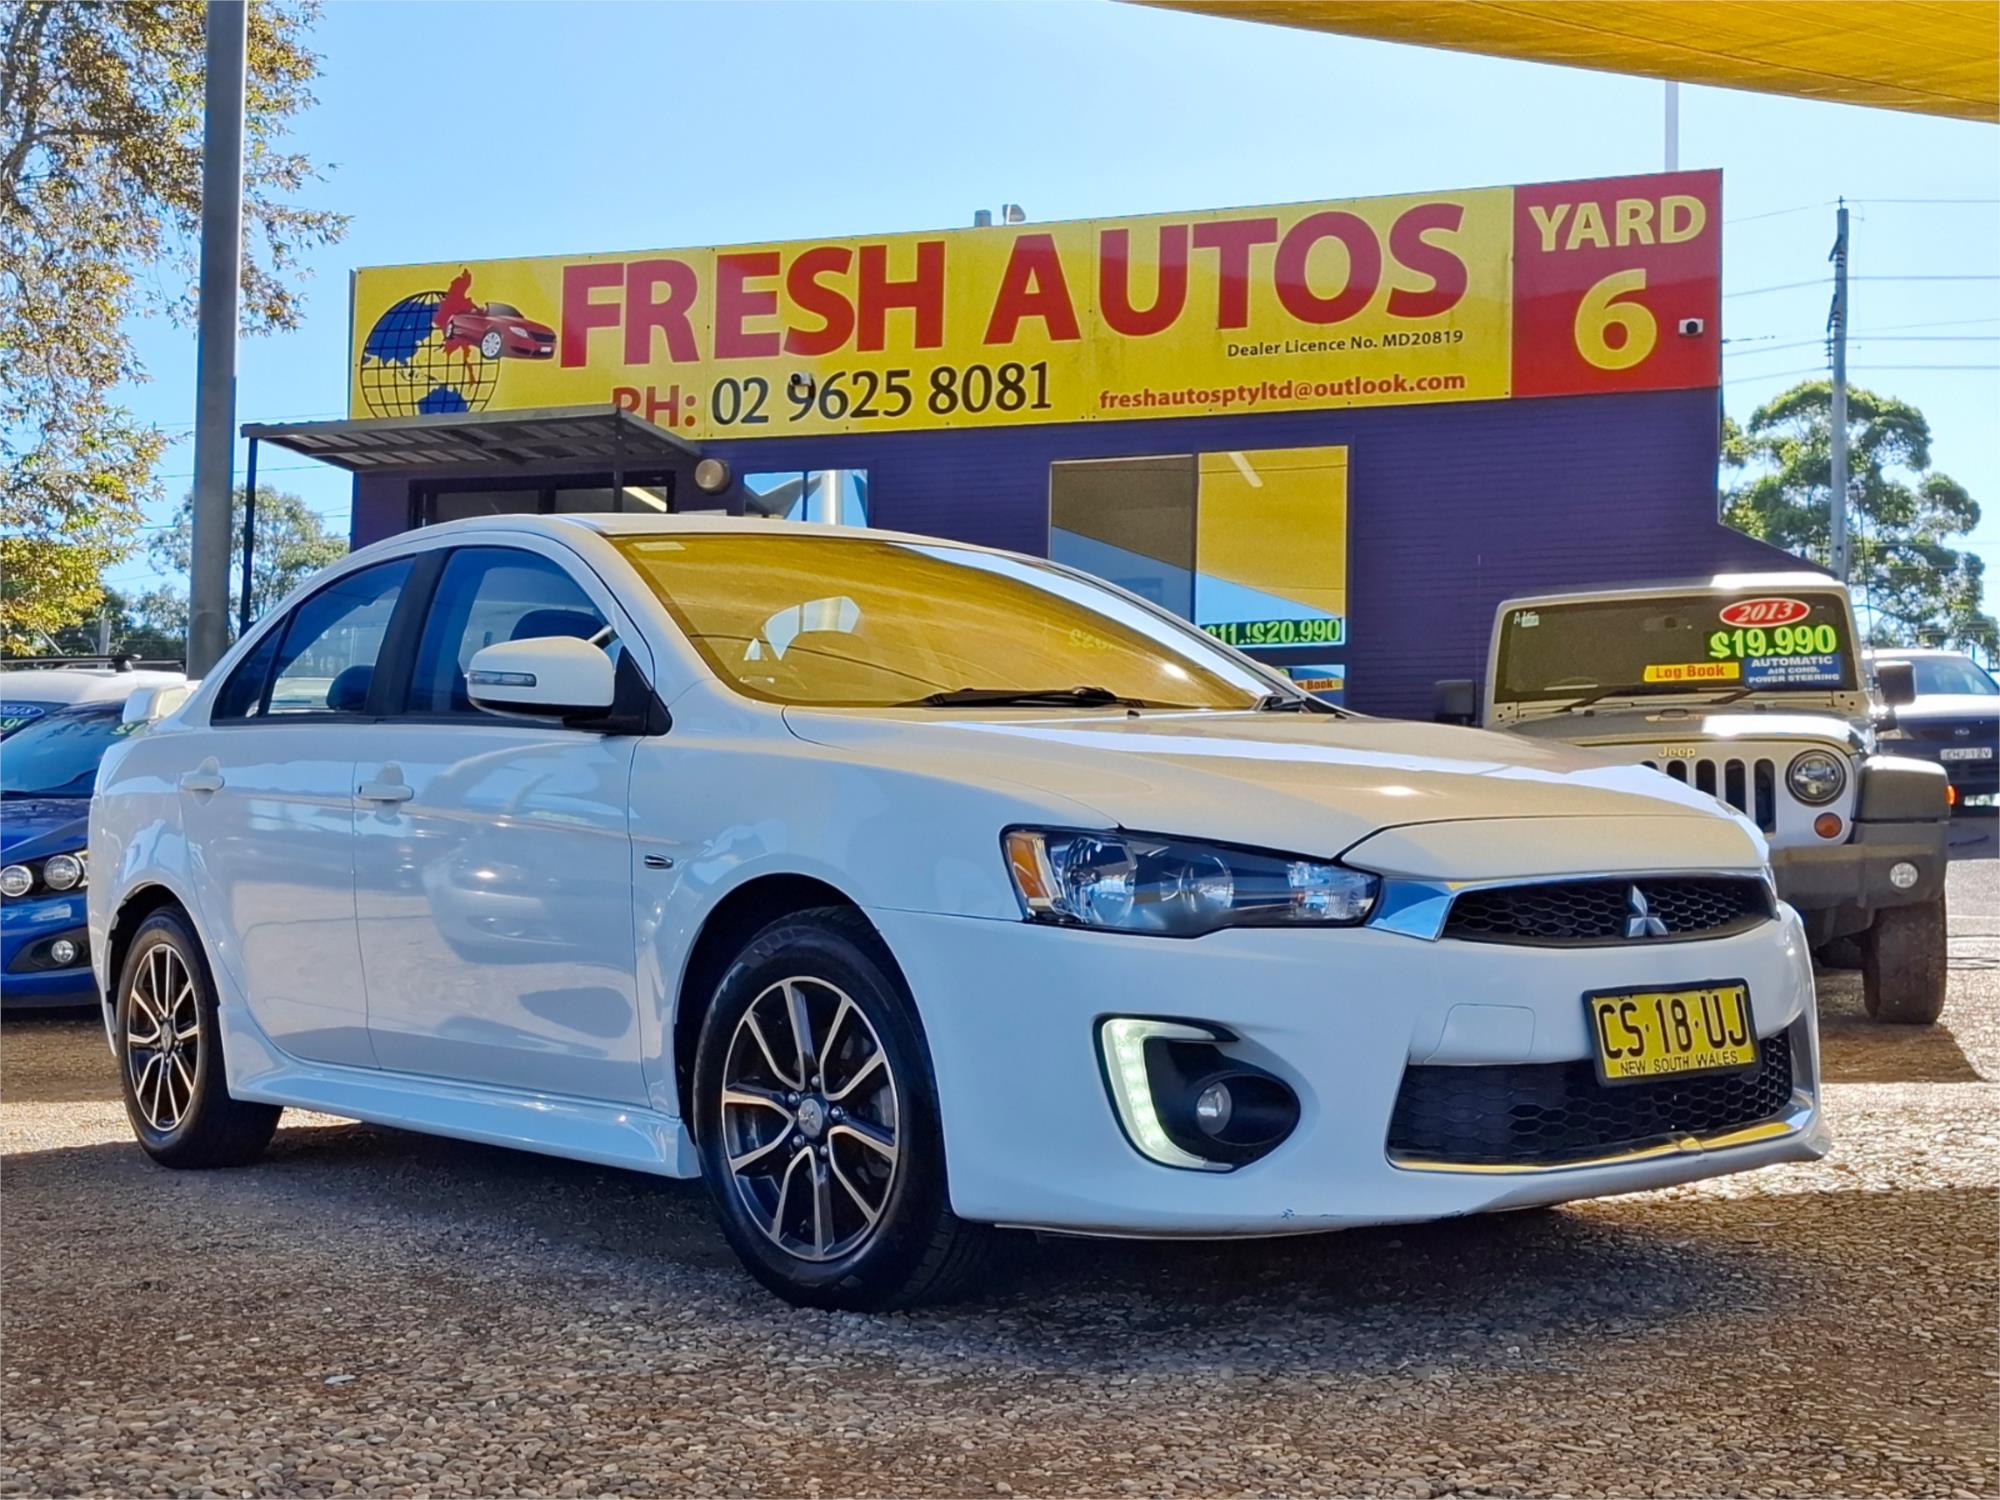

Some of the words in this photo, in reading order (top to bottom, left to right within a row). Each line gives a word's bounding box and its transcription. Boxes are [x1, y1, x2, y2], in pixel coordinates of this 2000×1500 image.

[1528, 194, 1707, 252] YARD
[560, 240, 946, 368] FRESH
[983, 202, 1469, 346] AUTOS
[1574, 268, 1657, 370] 6
[1227, 341, 1281, 357] Dealer
[1285, 338, 1346, 353] Licence
[1350, 336, 1378, 350] No.
[1382, 330, 1464, 347] MD20819
[612, 384, 697, 428] PH:
[711, 376, 769, 426] 02
[786, 368, 913, 423] 9625
[927, 360, 1052, 415] 8081
[1099, 372, 1467, 409] freshautosptyltd@outlook.com
[1734, 601, 1795, 623] 2013
[1250, 618, 1341, 643] $20.990
[1709, 623, 1837, 660] $19.990
[1655, 666, 1681, 679] Log
[1687, 664, 1725, 678] Book
[1751, 655, 1833, 668] AUTOMATIC
[1767, 667, 1786, 675] AIR
[1787, 666, 1820, 674] COND.
[1307, 679, 1333, 690] Book
[1748, 675, 1786, 684] POWER
[1787, 673, 1840, 682] STEERING
[1658, 746, 1696, 758] Jeep
[1620, 1060, 1646, 1076] NEW
[1654, 1055, 1689, 1073] SOUTH
[1695, 1050, 1738, 1067] WALES
